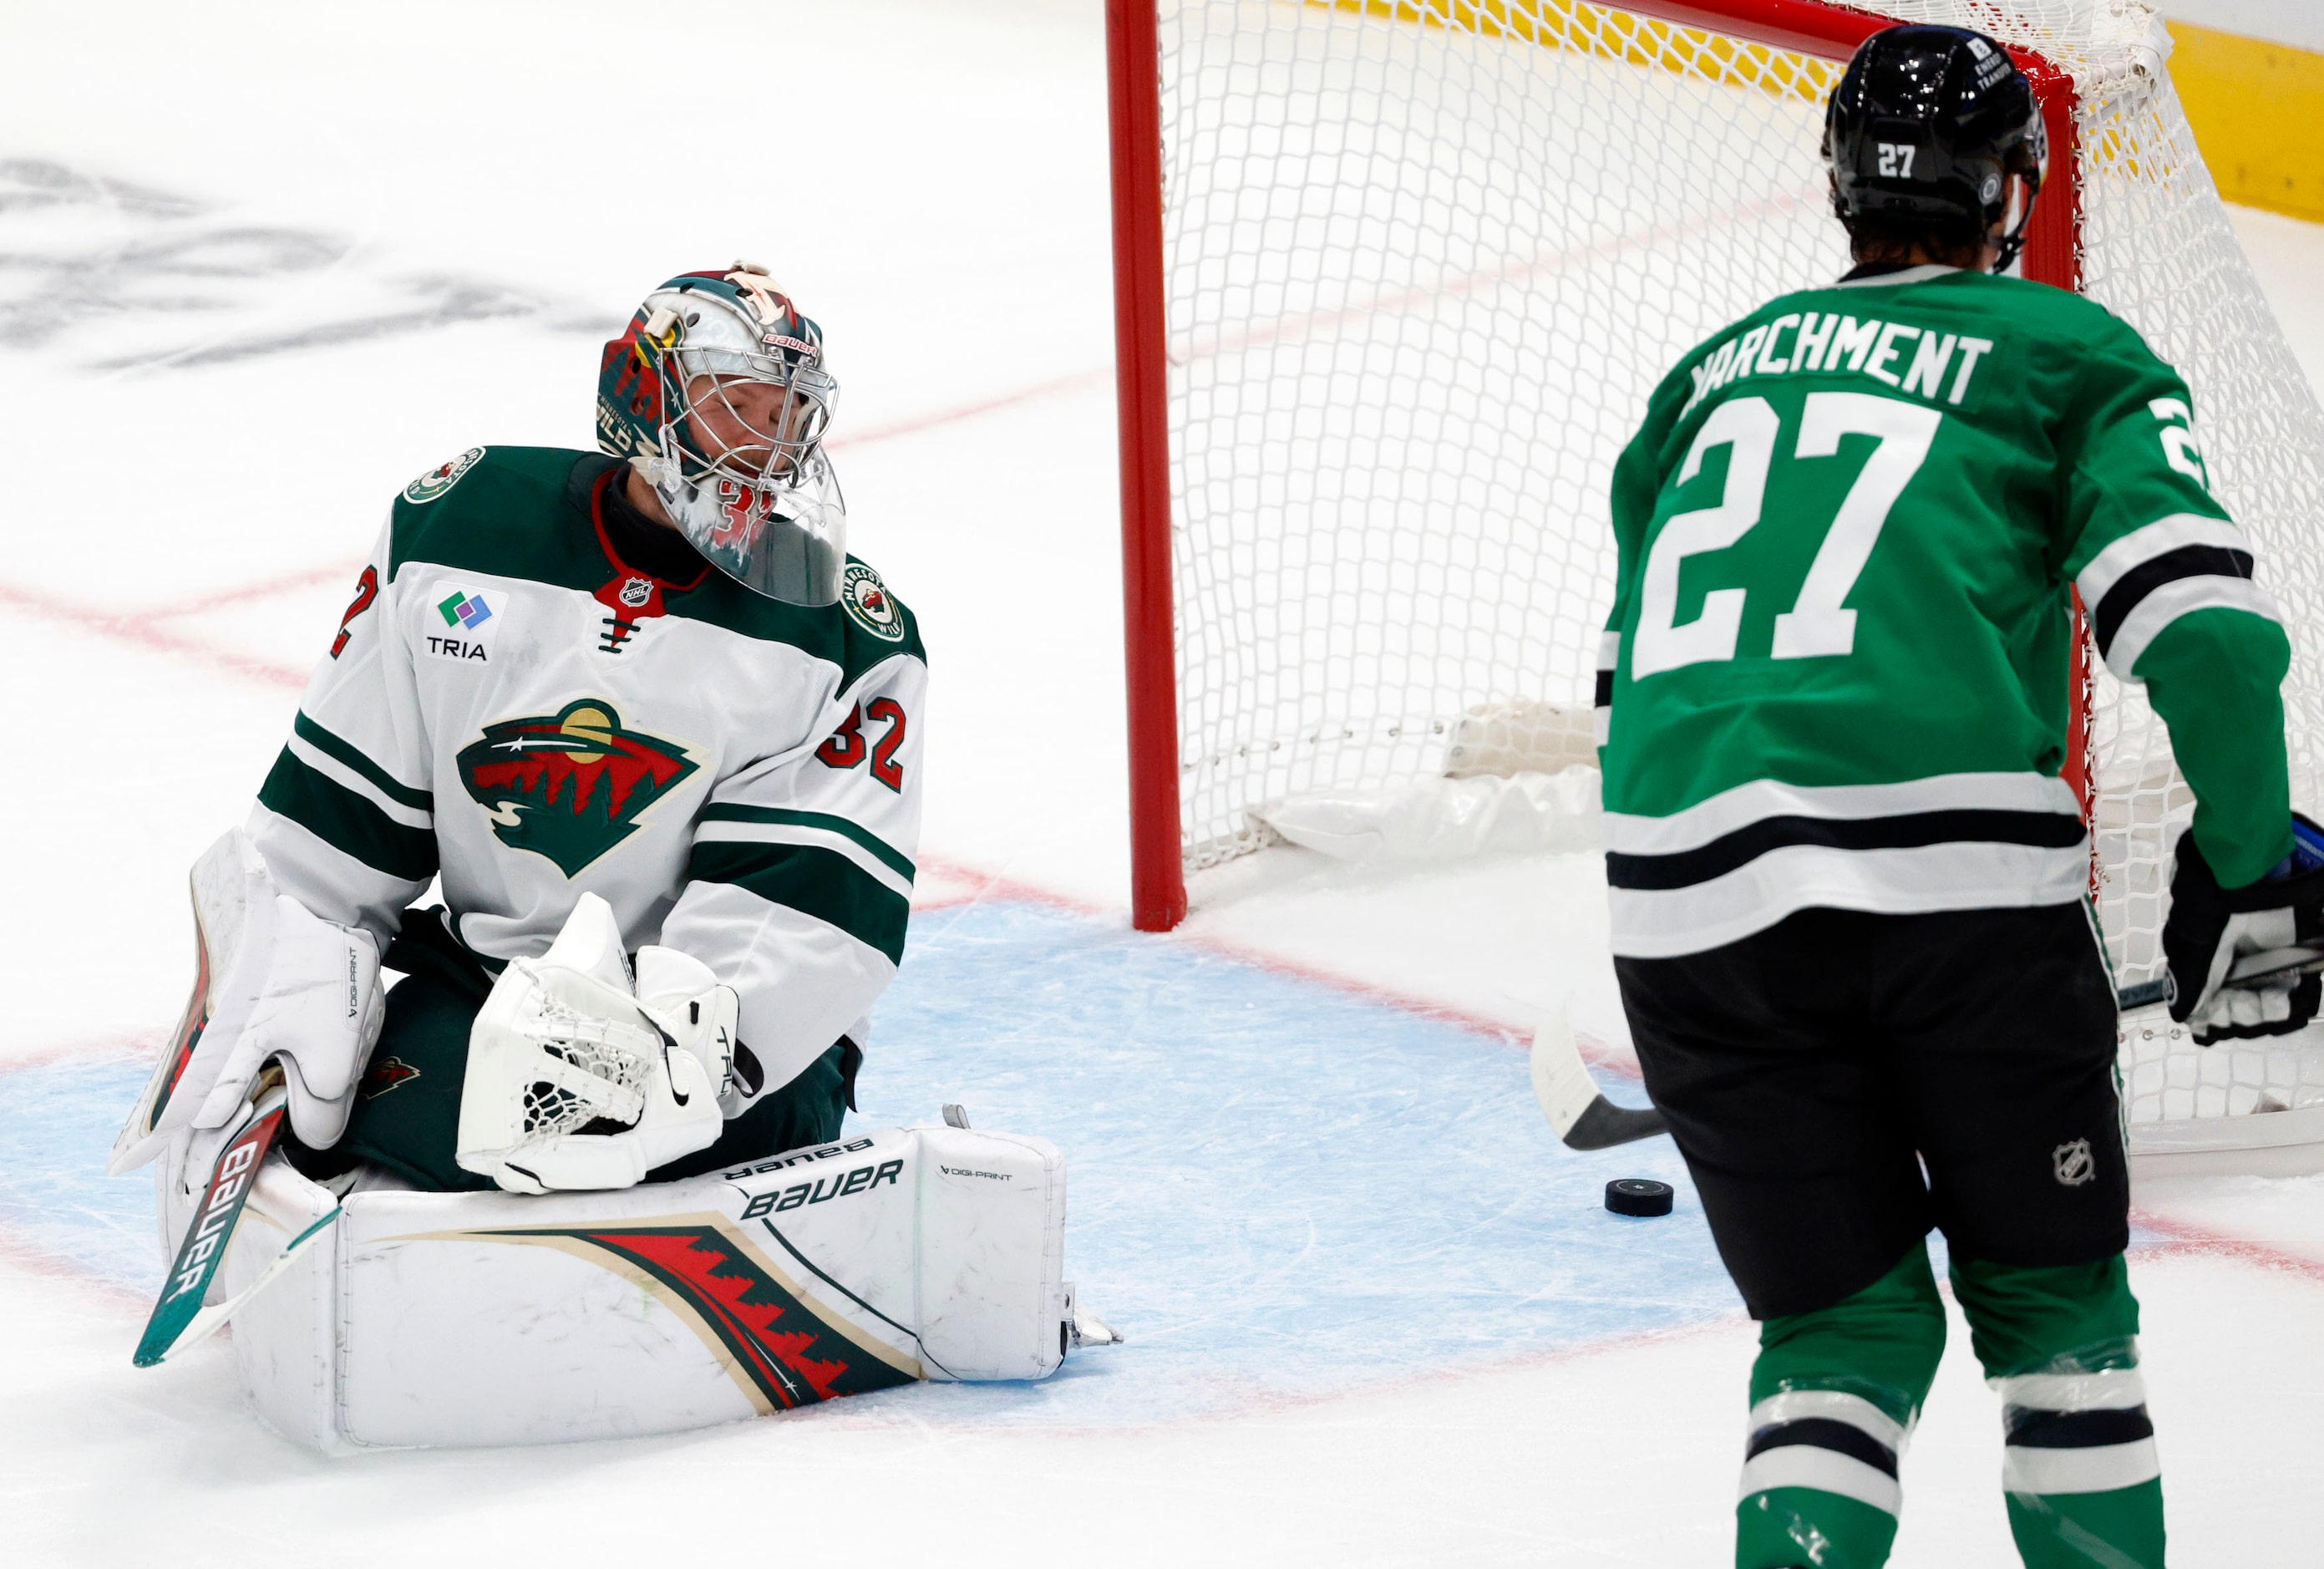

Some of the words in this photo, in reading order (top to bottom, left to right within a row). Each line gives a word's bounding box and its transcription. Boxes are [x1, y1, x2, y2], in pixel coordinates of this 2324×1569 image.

[1878, 143, 1916, 179] 27
[763, 334, 818, 358] BAUER
[1631, 392, 1943, 683] 27
[625, 586, 647, 600] NHL
[877, 622, 901, 636] WILD
[426, 637, 487, 662] TRIA
[814, 697, 907, 795] 32
[349, 946, 358, 1007] DIGI-PRINT
[721, 1138, 875, 1181] BAUER
[951, 1168, 1013, 1182] DIGI-PRINT
[740, 1159, 905, 1221] BAUER
[166, 1140, 259, 1303] BAUER
